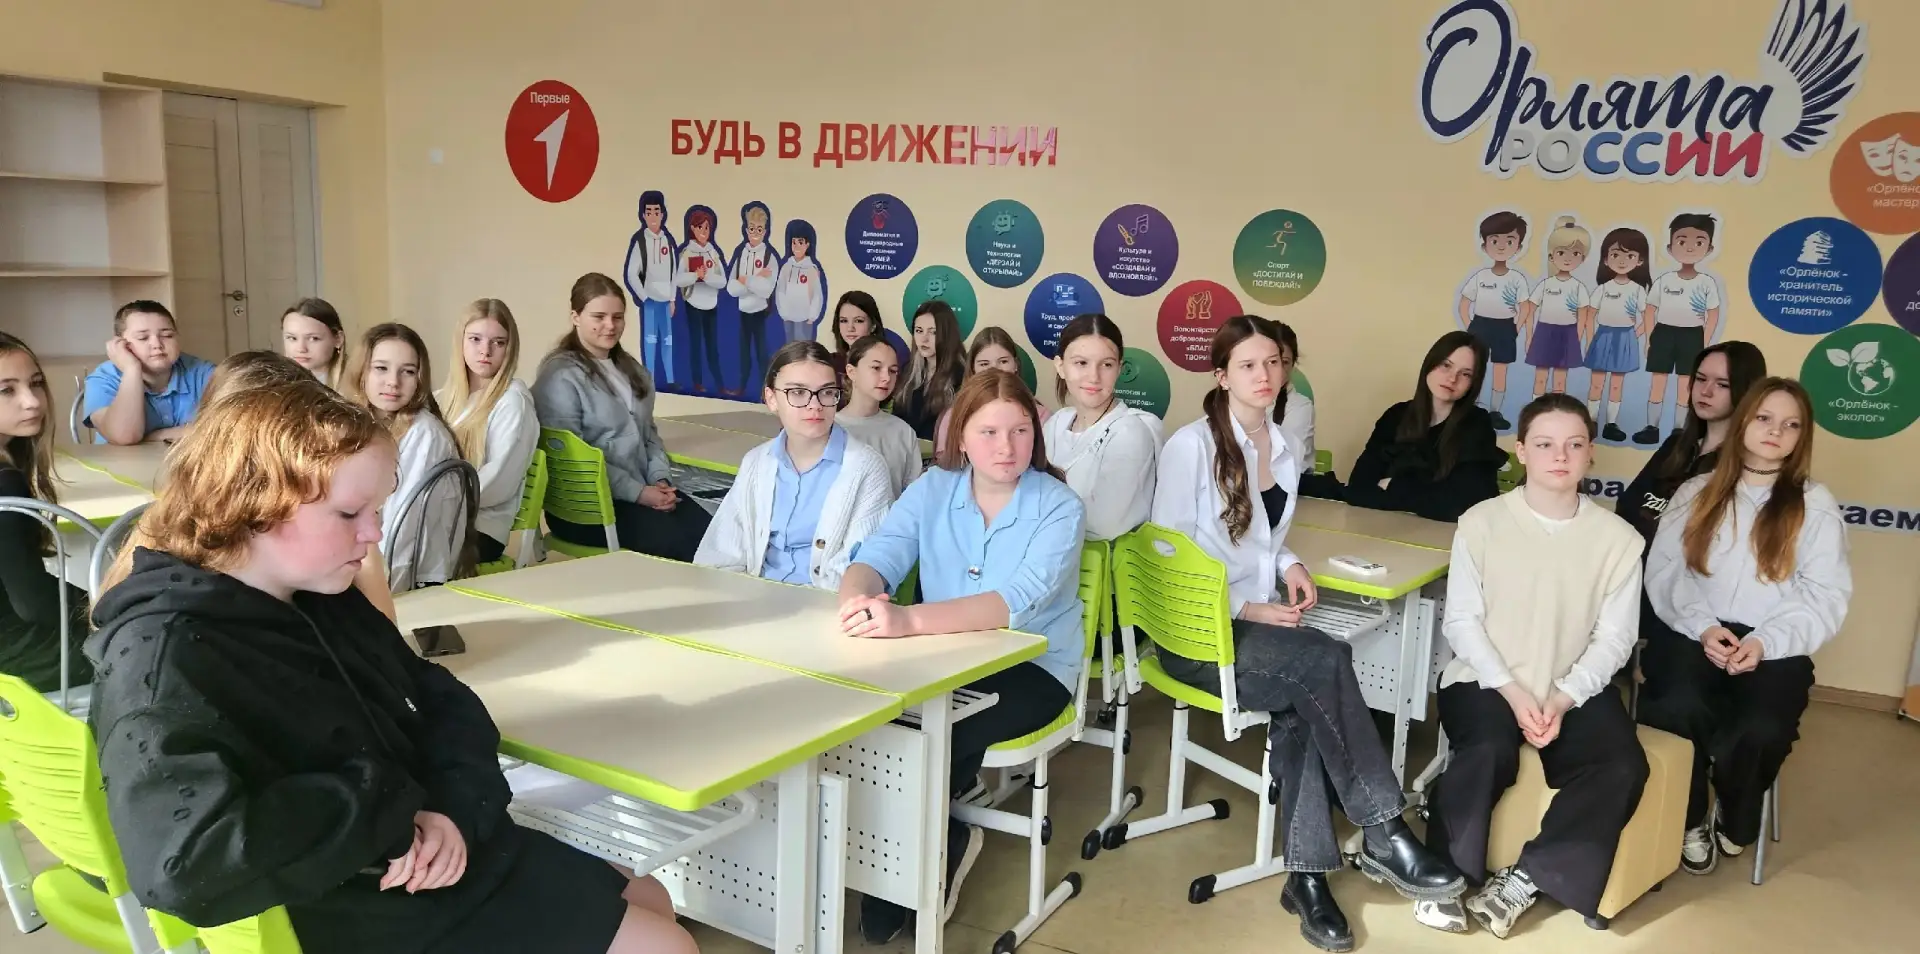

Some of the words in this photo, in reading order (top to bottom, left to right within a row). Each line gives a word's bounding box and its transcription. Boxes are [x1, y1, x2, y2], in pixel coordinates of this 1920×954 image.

[1421, 0, 1774, 166] Орлята
[530, 92, 570, 107] Первые
[671, 119, 765, 165] БУДЬ
[778, 121, 801, 159] В
[813, 122, 1058, 168] ДВИЖЕНИИ
[1498, 130, 1764, 178] РОССИИ
[992, 240, 1011, 249] Наука
[1118, 246, 1146, 255] Культура
[1267, 261, 1290, 270] Спорт
[1779, 266, 1840, 278] «Орлёнок
[1779, 281, 1844, 292] хранитель
[1767, 293, 1852, 305] исторической
[1780, 306, 1832, 317] памяти»
[1114, 388, 1140, 396] кология
[1828, 397, 1890, 410] «Орлёнок
[1836, 413, 1885, 422] эколог»
